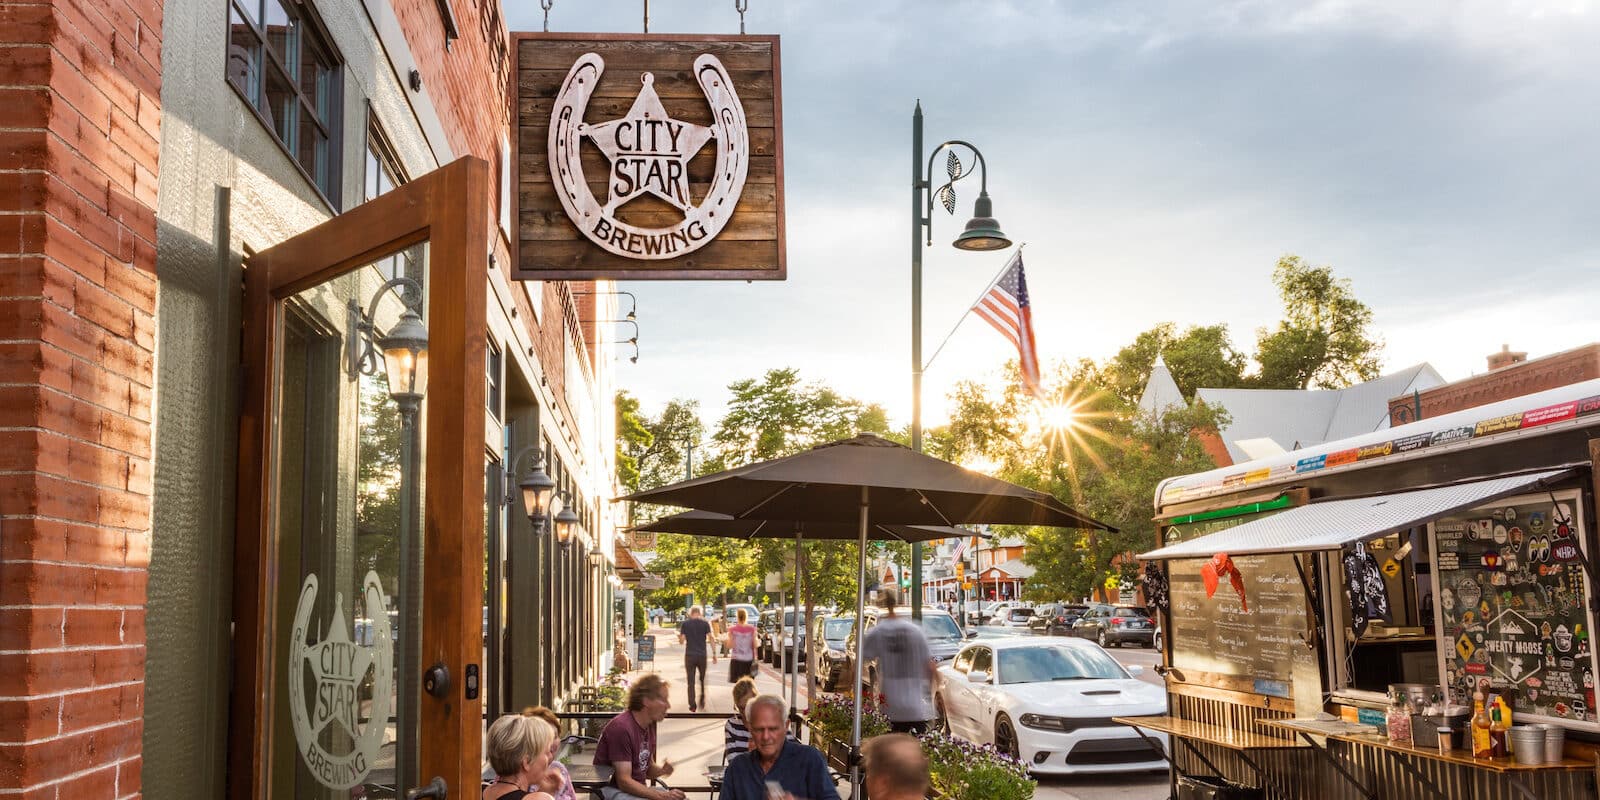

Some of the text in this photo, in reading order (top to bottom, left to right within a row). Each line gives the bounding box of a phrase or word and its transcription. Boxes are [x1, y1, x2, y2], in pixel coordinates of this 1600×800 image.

[615, 119, 683, 152] CITY
[614, 158, 684, 203] STAR
[592, 217, 708, 255] BREWING
[1556, 545, 1577, 559] NHRA
[320, 641, 357, 676] CITY
[1484, 639, 1544, 655] SWEATY MOOSE
[318, 682, 357, 732] STAR
[306, 741, 366, 784] BREWING
